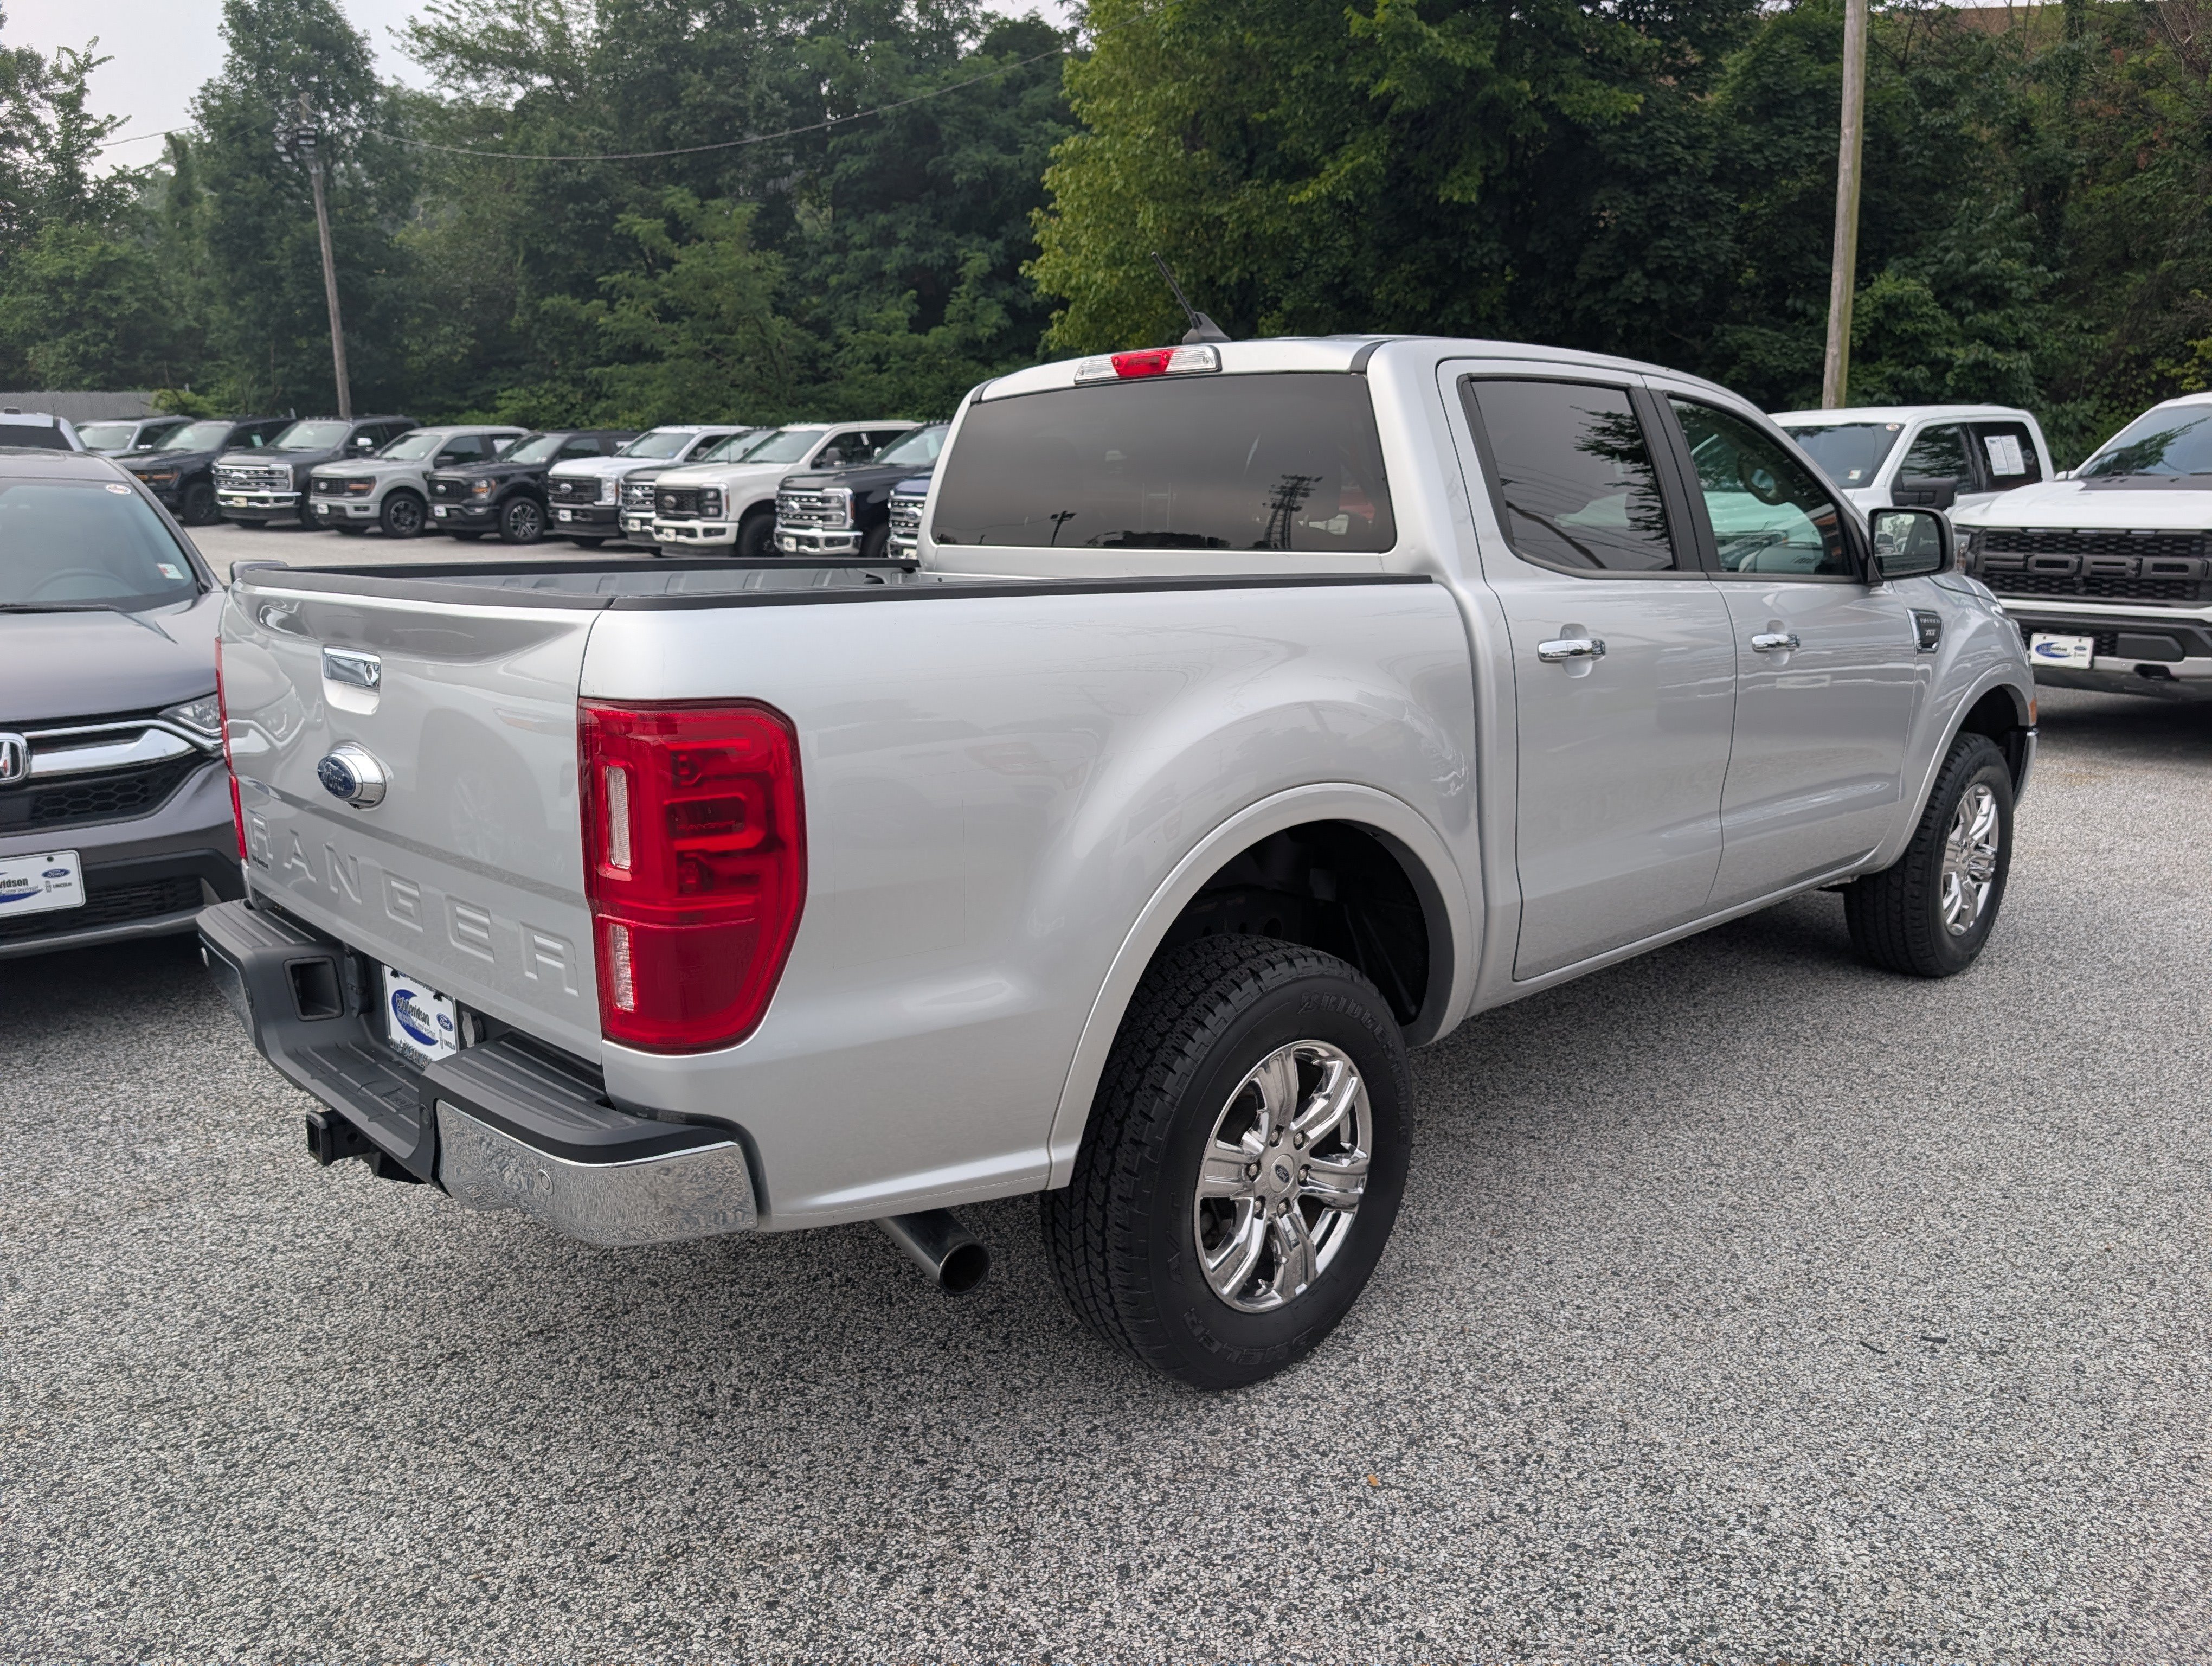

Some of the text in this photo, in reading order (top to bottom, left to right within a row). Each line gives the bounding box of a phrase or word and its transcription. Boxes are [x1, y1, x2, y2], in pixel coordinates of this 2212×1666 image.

[1973, 551, 2205, 580] FORD
[246, 809, 579, 997] RANGER
[406, 998, 430, 1028] Davidson
